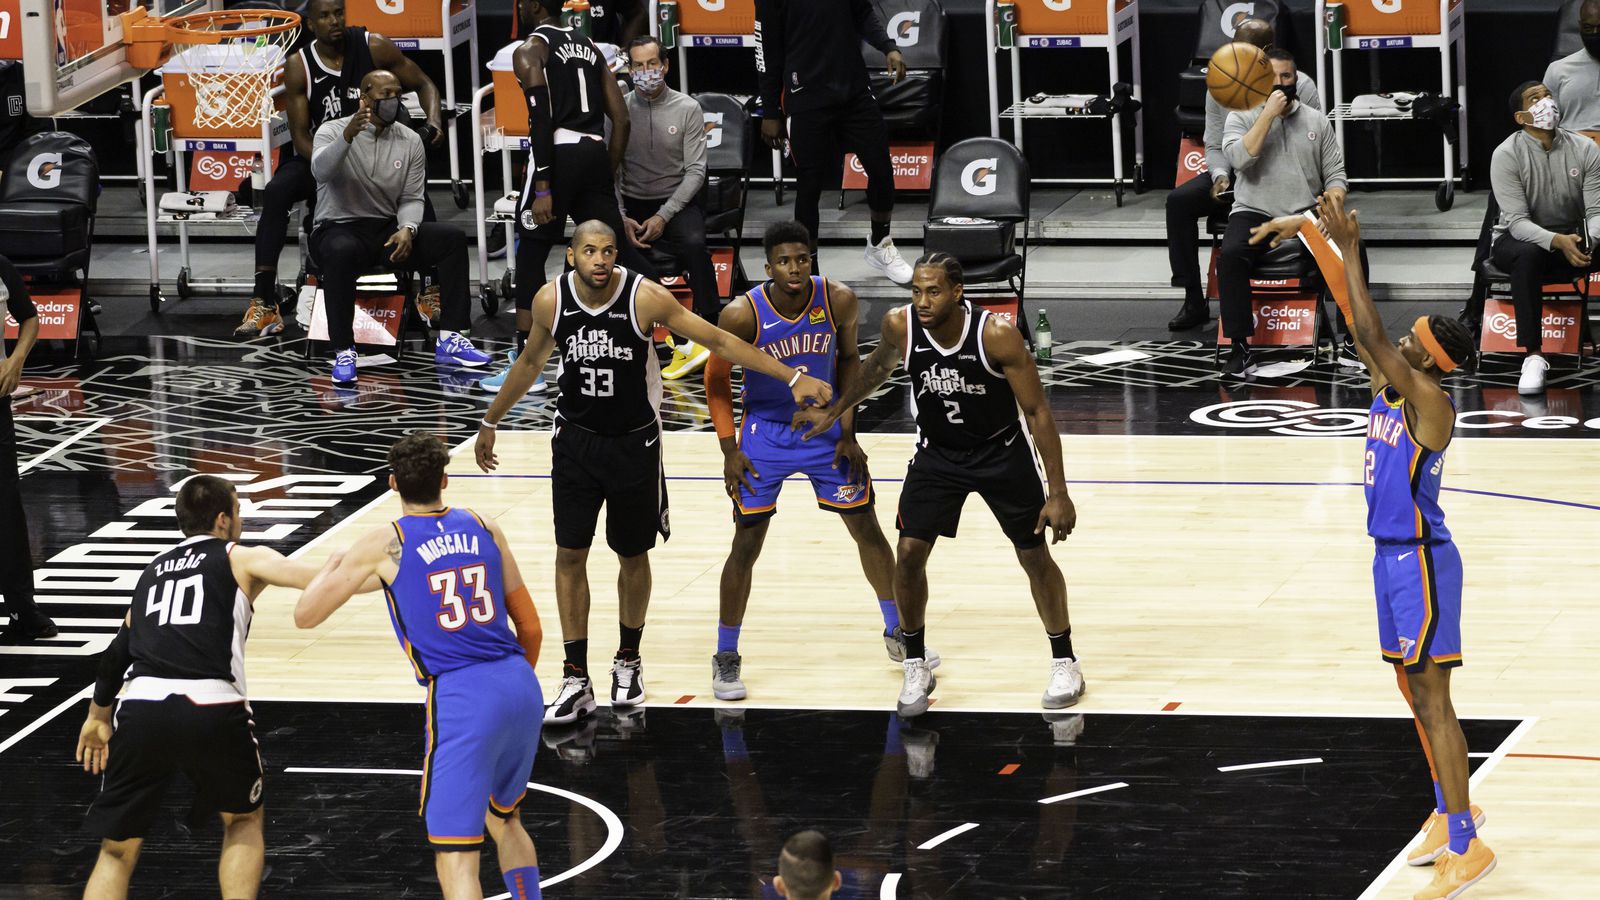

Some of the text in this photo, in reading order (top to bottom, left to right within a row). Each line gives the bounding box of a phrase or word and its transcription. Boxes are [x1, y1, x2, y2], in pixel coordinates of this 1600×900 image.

[555, 43, 597, 66] JACKSON
[577, 68, 589, 113] 1
[27, 152, 62, 189] G
[960, 157, 997, 195] G
[608, 311, 628, 320] honey
[1260, 306, 1310, 317] Cedars
[1266, 319, 1301, 330] Sinai
[1541, 313, 1575, 326] dars
[576, 325, 608, 344] Los
[1541, 327, 1566, 338] inai
[565, 335, 633, 365] Angeles
[580, 367, 614, 397] 33
[917, 370, 987, 399] Angeles
[930, 363, 960, 382] Los
[943, 400, 964, 424] 2
[1365, 450, 1376, 486] 2
[416, 533, 480, 565] MUSCALA
[145, 574, 204, 626] 40
[428, 563, 496, 632] 33
